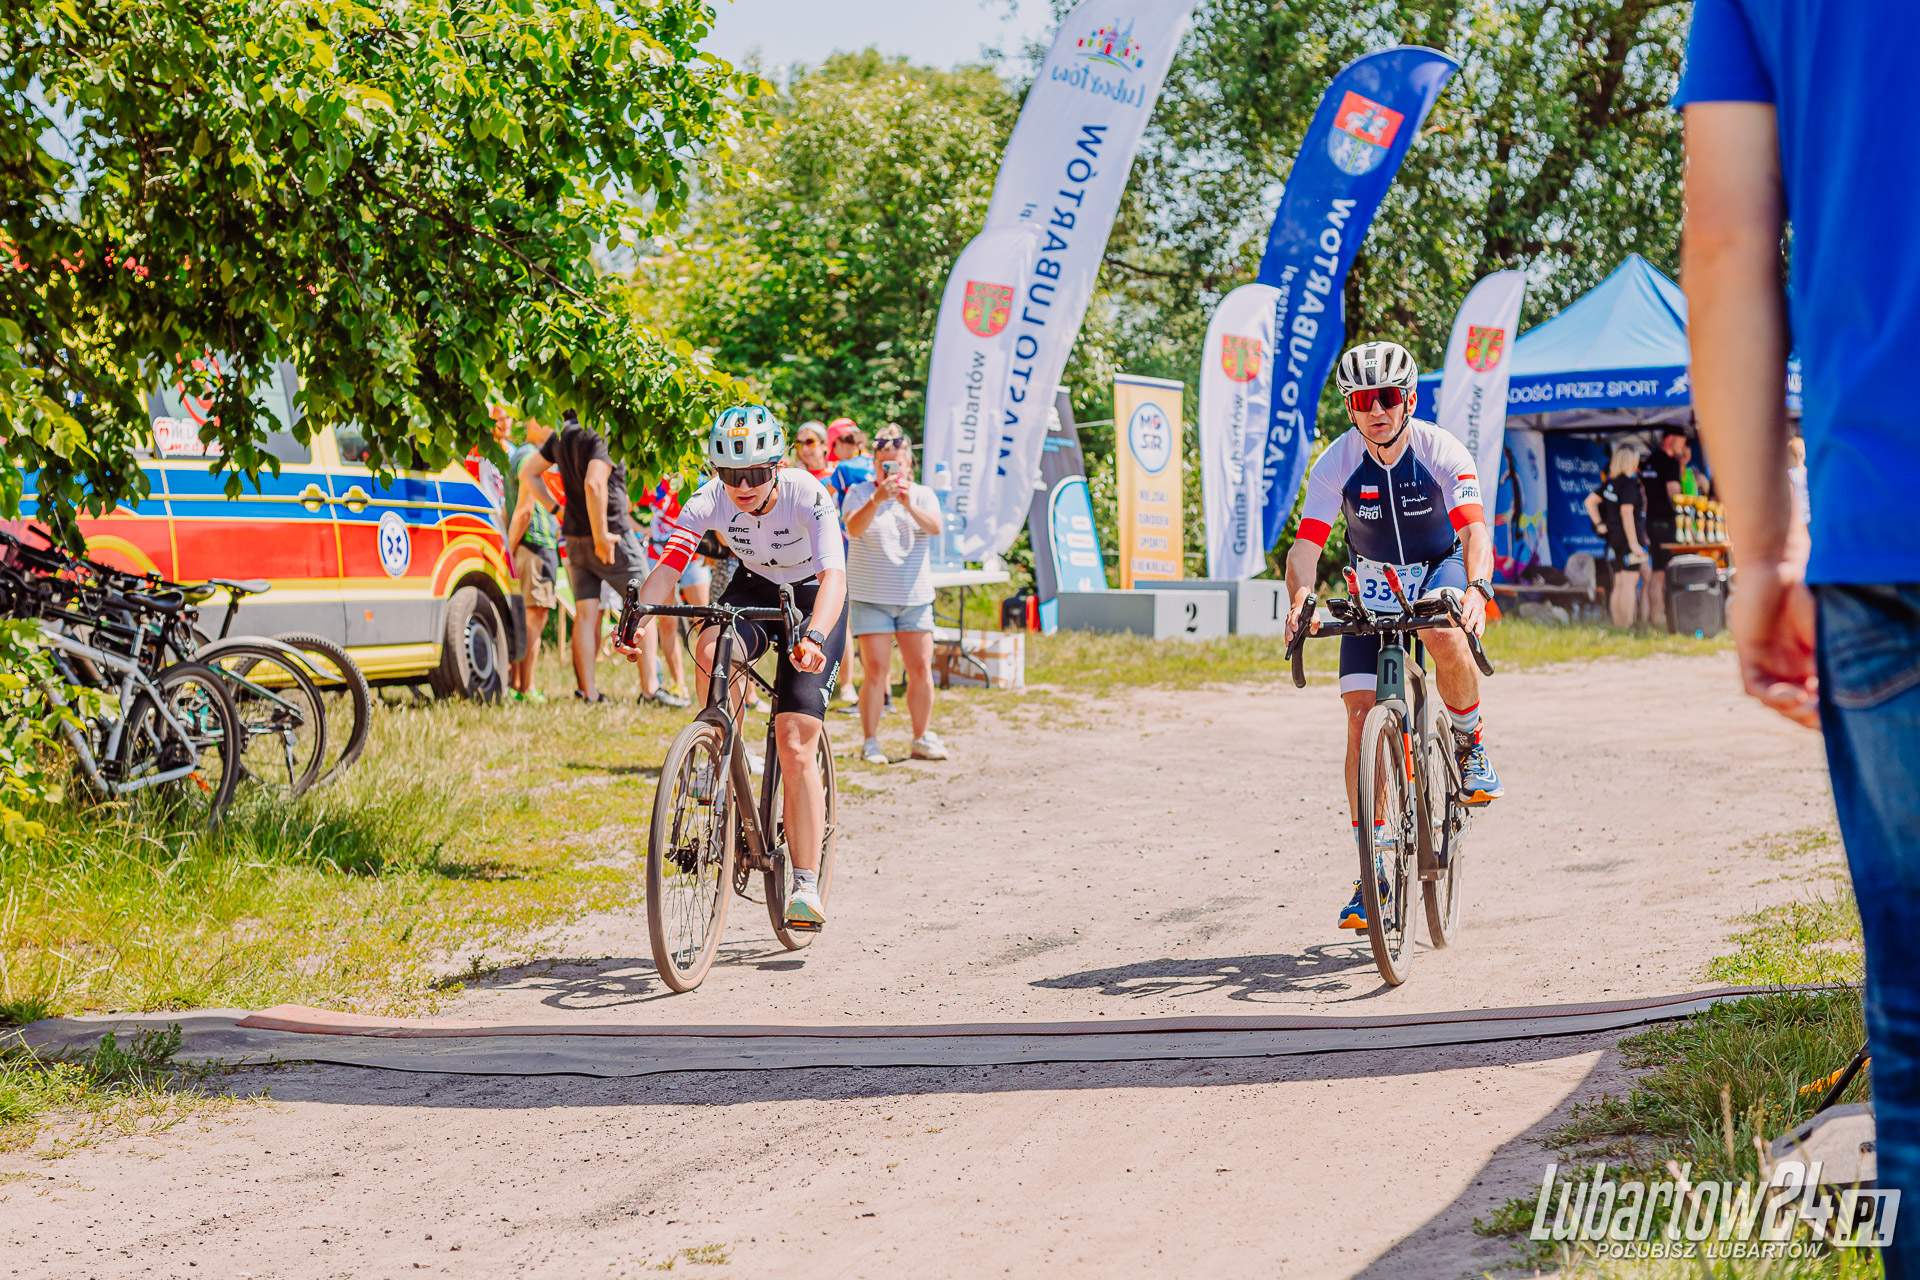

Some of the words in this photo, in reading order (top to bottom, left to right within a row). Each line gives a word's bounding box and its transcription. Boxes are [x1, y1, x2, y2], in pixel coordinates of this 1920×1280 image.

[956, 350, 986, 454] Lubartów
[1555, 381, 1605, 400] PRZEZ
[1606, 379, 1660, 397] SPORT
[1466, 384, 1484, 462] bartów
[1231, 491, 1248, 557] Gmina
[1272, 591, 1278, 620] 1
[1363, 578, 1416, 604] 331
[1186, 602, 1198, 633] 2
